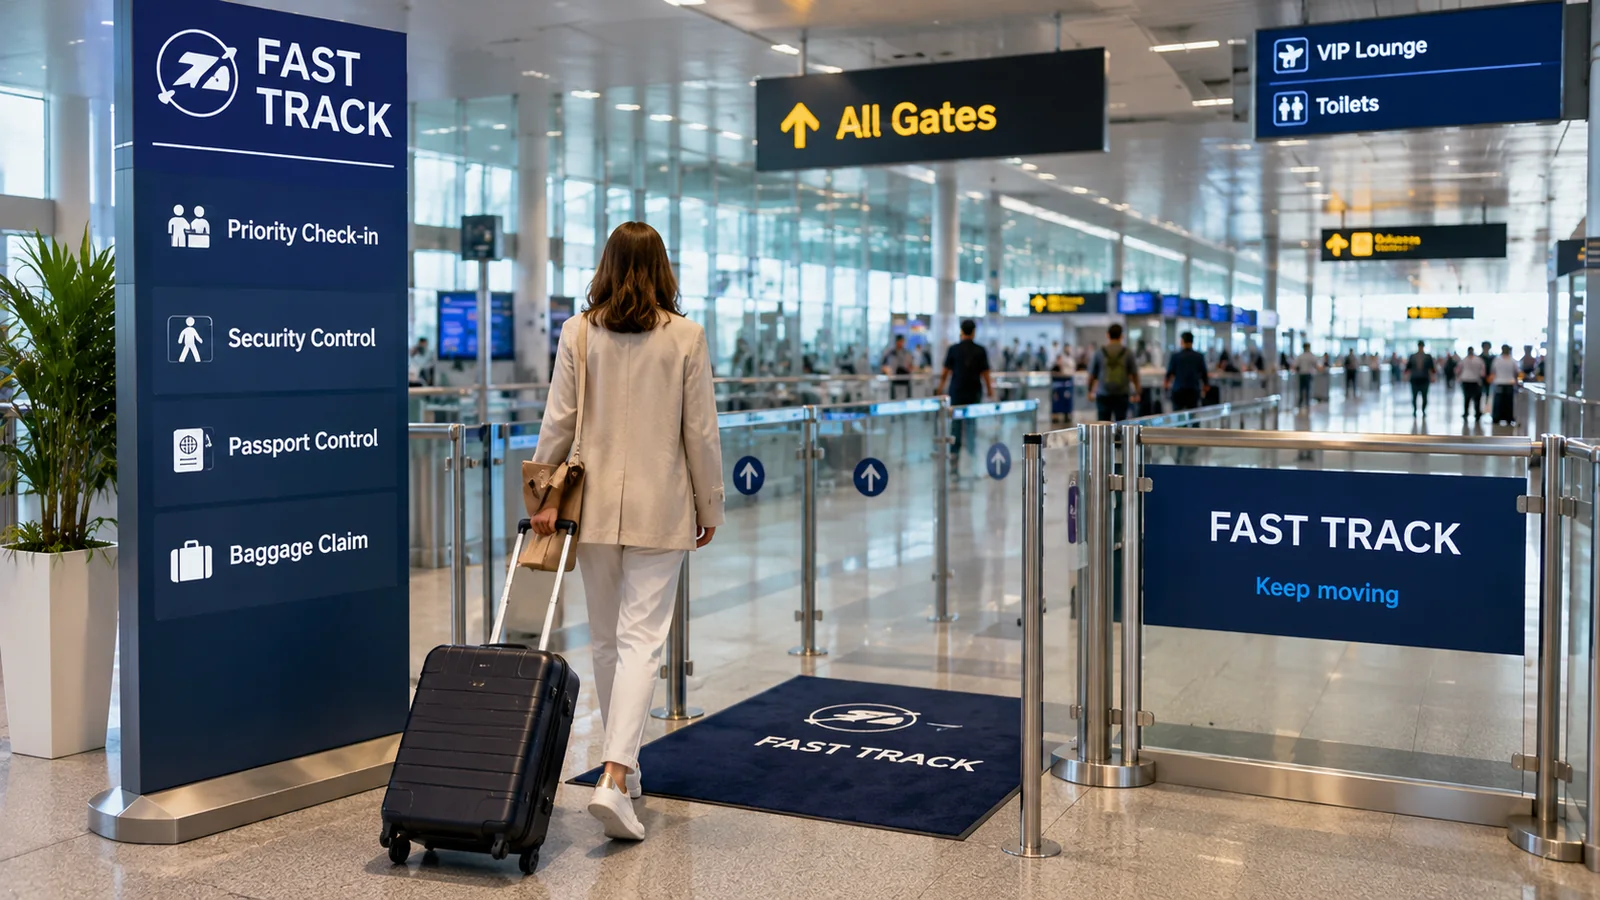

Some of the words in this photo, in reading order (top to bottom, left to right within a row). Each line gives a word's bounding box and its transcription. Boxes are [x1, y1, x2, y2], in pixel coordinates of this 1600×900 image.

[258, 37, 361, 87] FAST
[1316, 42, 1350, 62] VIP
[1355, 39, 1428, 60] Lounge
[256, 86, 393, 138] TRACK
[836, 103, 882, 140] All
[892, 101, 997, 137] Gates
[1316, 95, 1380, 115] Toilets
[228, 218, 297, 247] Priority
[302, 223, 379, 246] Check-in
[228, 327, 306, 353] Security
[311, 327, 376, 348] Control
[229, 432, 311, 458] Passport
[315, 428, 378, 450] Control
[230, 540, 313, 567] Baggage
[318, 531, 369, 554] Claim
[1210, 510, 1309, 546] FAST
[1321, 515, 1462, 556] TRACK
[1256, 576, 1310, 603] Keep
[1317, 582, 1400, 609] moving
[754, 735, 851, 756] FAST
[856, 746, 985, 773] TRACK
